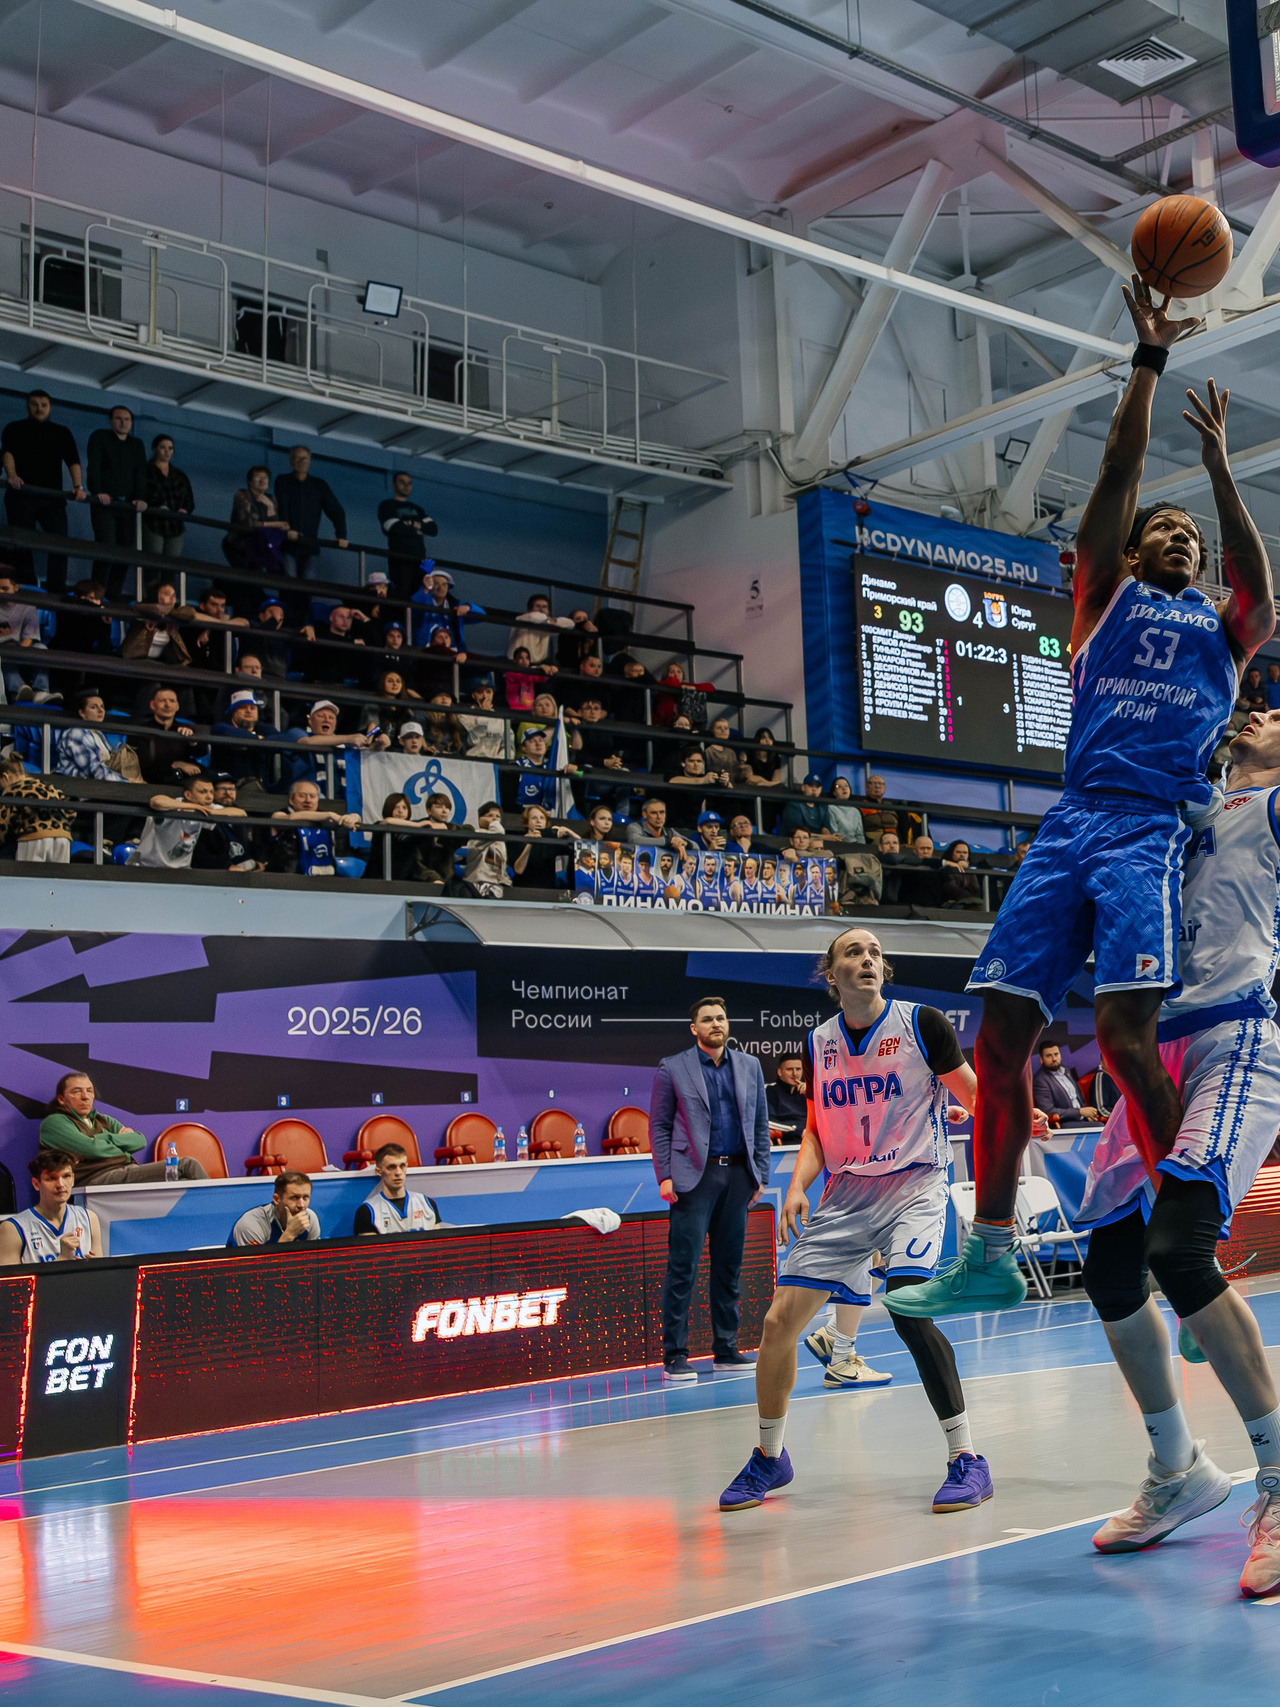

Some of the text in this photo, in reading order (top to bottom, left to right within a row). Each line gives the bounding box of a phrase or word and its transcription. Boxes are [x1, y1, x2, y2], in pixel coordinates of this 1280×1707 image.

[750, 579, 760, 600] 5
[861, 573, 897, 590] Динамо
[862, 587, 937, 611] Приморский край
[873, 605, 925, 634] 3 93
[972, 611, 984, 629] 4
[1011, 604, 1032, 617] Югра
[1011, 617, 1037, 632] Сургут
[861, 633, 866, 642] 1
[872, 635, 899, 647] ЕРШОВ
[936, 638, 944, 647] 17
[1038, 635, 1061, 658] 83
[1133, 626, 1181, 670] 53
[861, 642, 867, 651] 2
[936, 655, 945, 665] 10
[861, 651, 868, 660] 3
[873, 653, 906, 666] ЗАХАРОВ
[936, 664, 942, 672] 2
[955, 640, 1008, 665] 01:22:3
[1012, 653, 1017, 661] 1
[873, 662, 920, 677] ДЕСЯТНИКОВ
[936, 672, 942, 681] 4
[1012, 661, 1018, 670] 2
[862, 678, 872, 687] 21
[937, 689, 943, 698] 4
[863, 687, 873, 696] 27
[874, 688, 908, 701] АКСЕНОВ
[936, 681, 943, 690] 0
[1014, 686, 1020, 694] 7
[1094, 676, 1198, 710] ПРИМОРСКИЙ
[956, 696, 963, 706] 1
[1002, 703, 1010, 714] 3
[938, 716, 945, 725] 0
[1112, 700, 1158, 723] КРАЙ
[863, 713, 871, 722] 0
[939, 724, 946, 733] 0
[864, 722, 871, 732] 0
[939, 733, 946, 742] 0
[1016, 744, 1024, 753] 0
[511, 979, 629, 1001] Чемпионат
[287, 1005, 423, 1037] 2025/26
[511, 1009, 593, 1029] России
[760, 1009, 822, 1028] Fonbet
[725, 1036, 804, 1058] Суперли
[877, 1045, 900, 1057] BET
[879, 1036, 901, 1048] FON
[374, 1093, 381, 1104] 4
[822, 1070, 904, 1110] ЮГРА
[179, 1100, 186, 1110] 2
[860, 1114, 871, 1147] 1
[411, 1287, 569, 1342] FONBET
[44, 1334, 114, 1366] FON
[44, 1361, 115, 1395] BET
